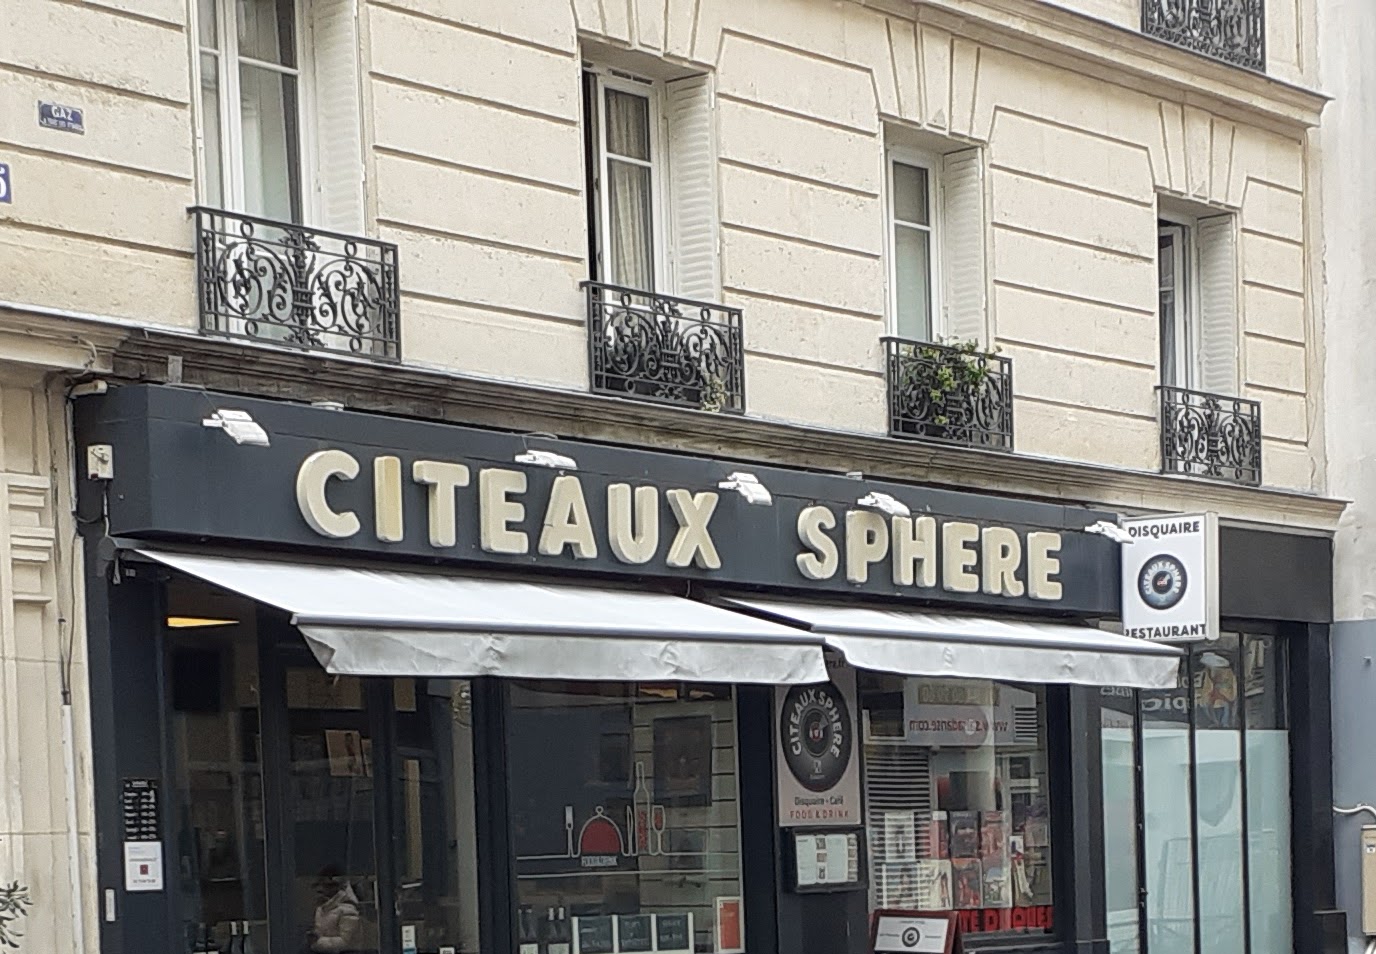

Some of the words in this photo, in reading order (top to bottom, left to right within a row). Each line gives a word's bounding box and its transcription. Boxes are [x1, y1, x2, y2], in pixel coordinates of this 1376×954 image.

[296, 449, 722, 570] CITEAUX
[795, 505, 1064, 601] SPHERE
[1128, 521, 1200, 539] DISQUAIRE
[788, 688, 817, 756] CITEAUX
[818, 690, 843, 759] SPHERE
[959, 909, 979, 933] TE
